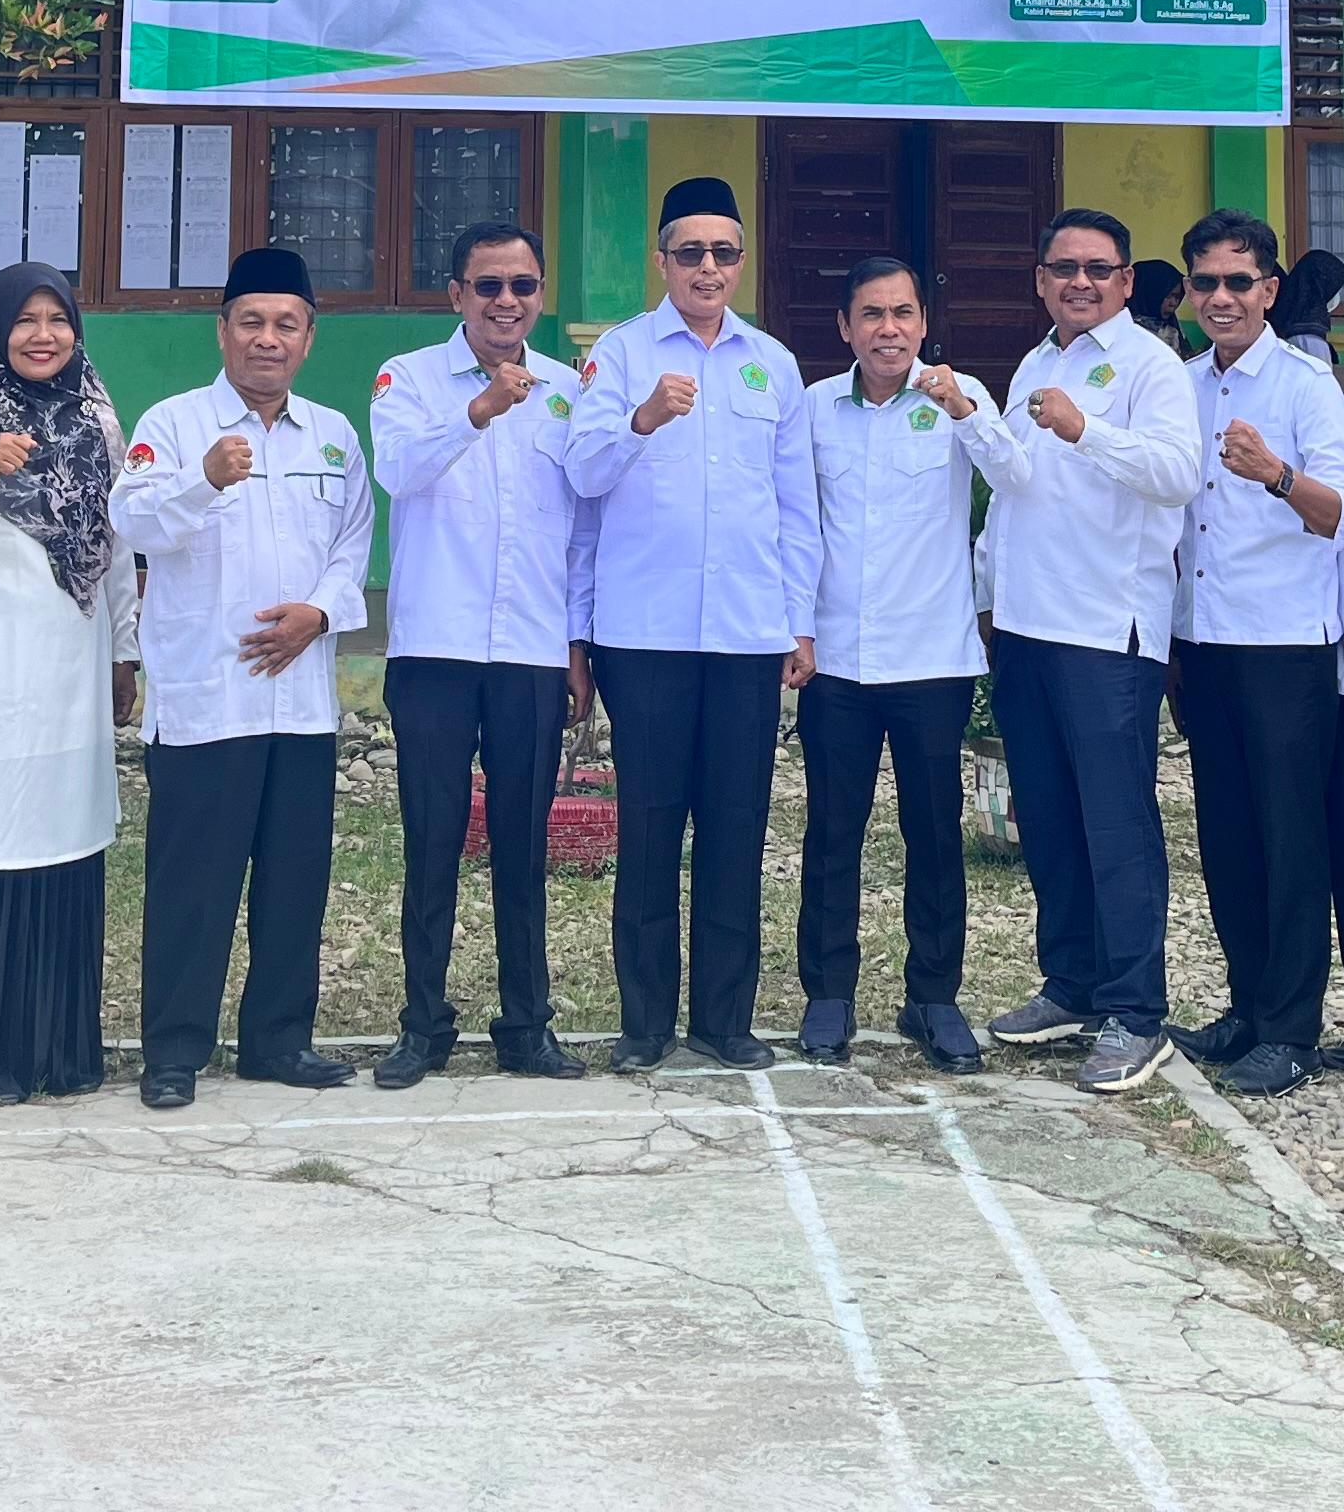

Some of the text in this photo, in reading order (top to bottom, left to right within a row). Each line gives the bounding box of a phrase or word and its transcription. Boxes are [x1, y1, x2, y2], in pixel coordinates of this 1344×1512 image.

[1173, 0, 1183, 9] H.
[1023, 7, 1044, 15] Kabid
[1208, 11, 1224, 19] Kota
[1225, 13, 1250, 21] Langsa
